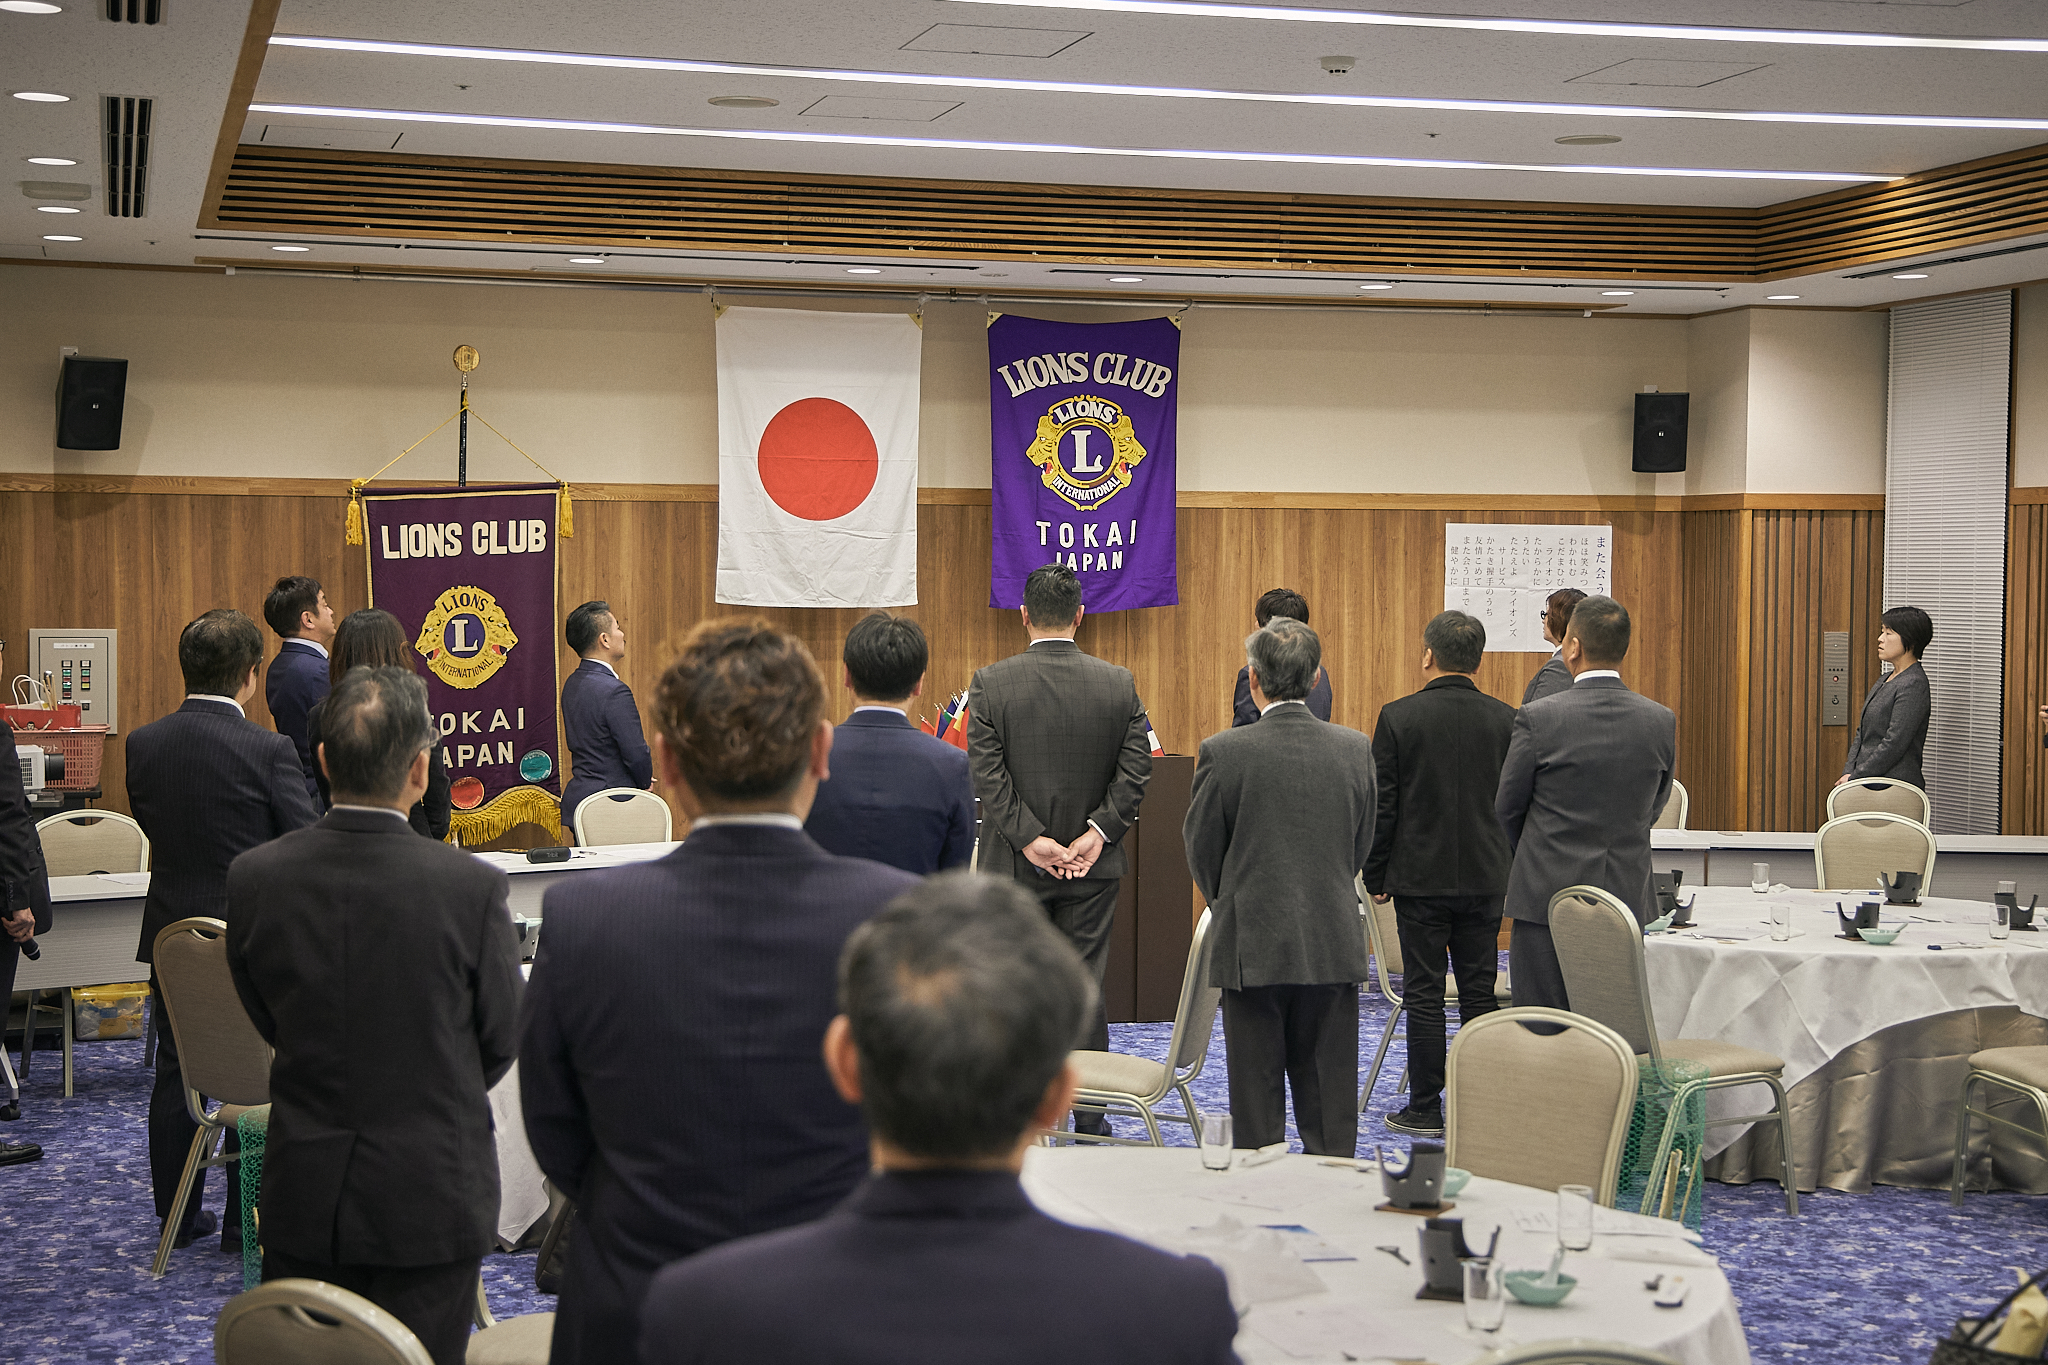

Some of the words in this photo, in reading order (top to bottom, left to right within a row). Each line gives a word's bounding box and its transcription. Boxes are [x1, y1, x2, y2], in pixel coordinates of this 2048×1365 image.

[997, 352, 1089, 398] LIONS
[1093, 352, 1172, 398] CLUB
[1053, 401, 1117, 424] LIONS
[1071, 430, 1104, 472] L
[1051, 475, 1121, 501] INTERNATIONAL
[381, 522, 463, 559] LIONS
[472, 519, 547, 555] CLUB
[1036, 519, 1137, 549] TOKAI
[1522, 536, 1530, 565] うたい
[1450, 546, 1459, 586] 健やかに
[1462, 536, 1471, 606] また会う日まで
[1474, 536, 1483, 586] 友情こめて
[1498, 547, 1507, 586] サービス
[1533, 537, 1542, 586] たからかに
[1568, 537, 1578, 577] わかれむ
[441, 593, 489, 614] LIONS
[451, 619, 479, 652] L
[439, 658, 494, 678] INTERNATIONAL
[431, 707, 524, 736] OKAI
[442, 741, 514, 769] APAN
